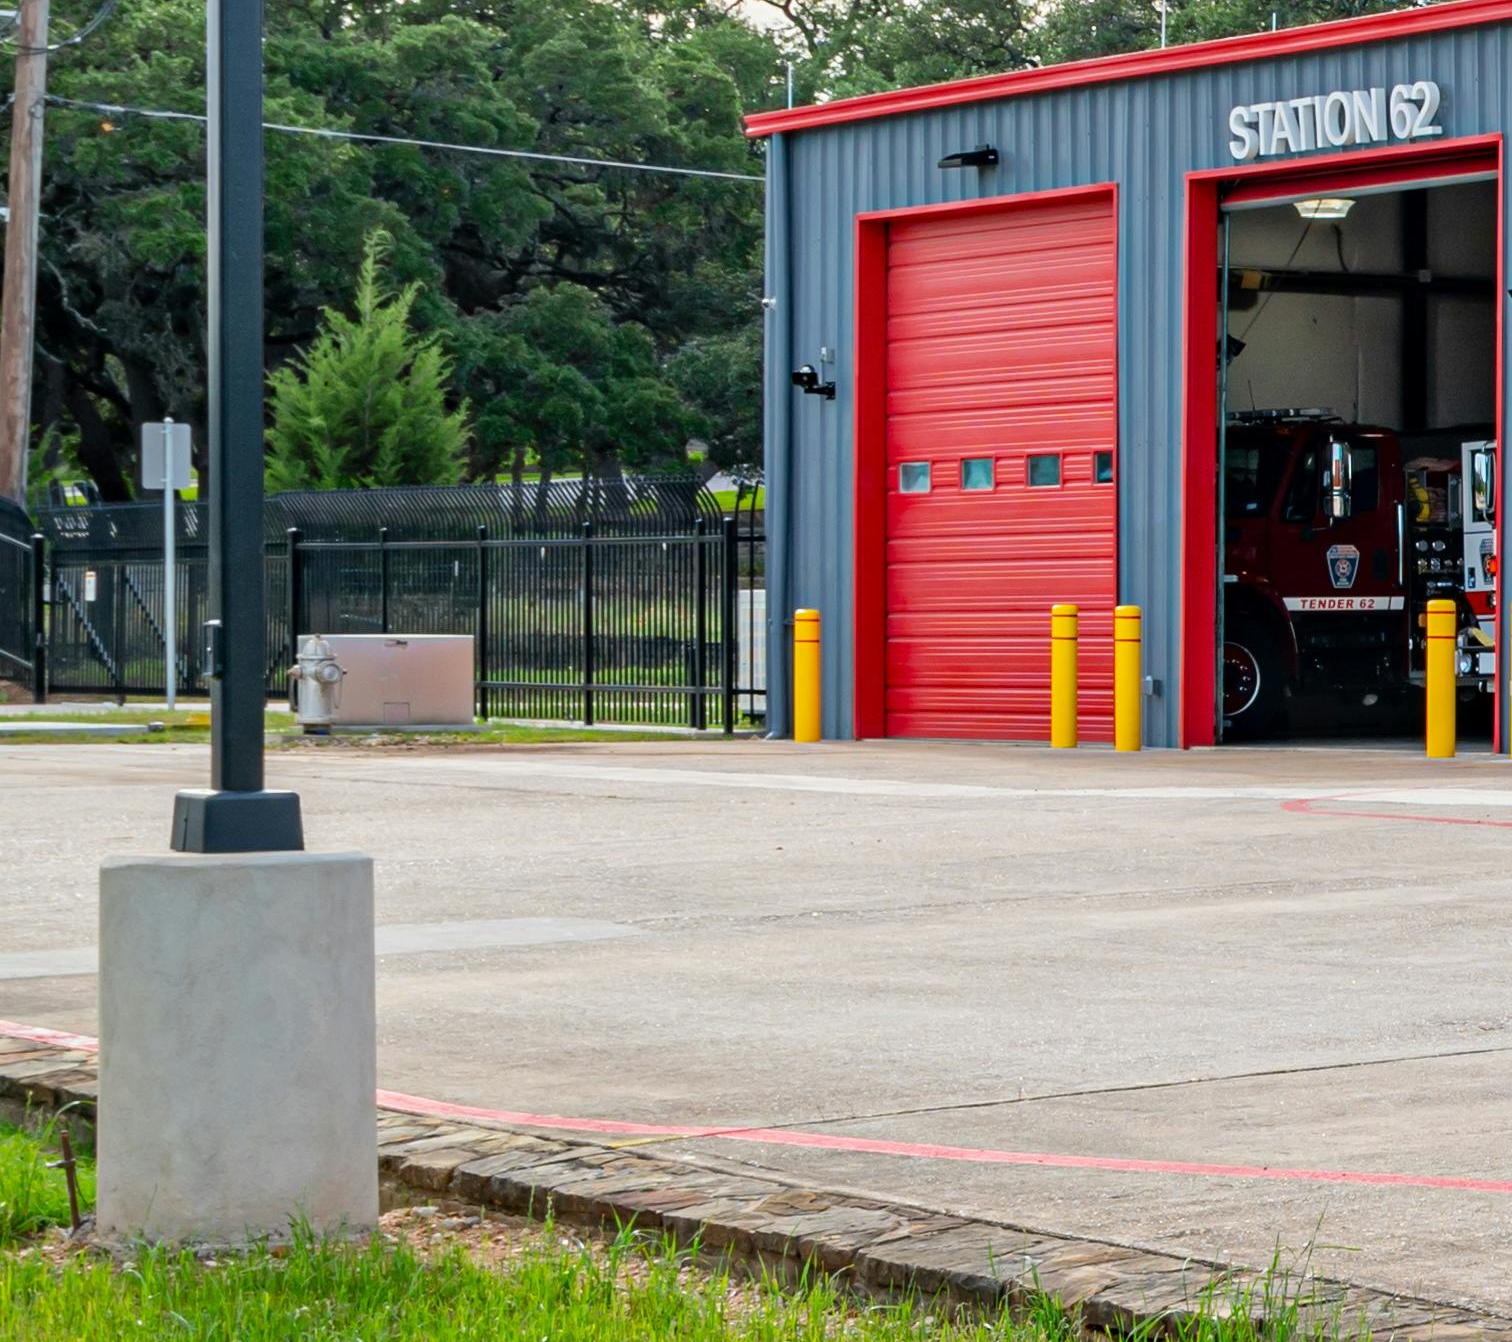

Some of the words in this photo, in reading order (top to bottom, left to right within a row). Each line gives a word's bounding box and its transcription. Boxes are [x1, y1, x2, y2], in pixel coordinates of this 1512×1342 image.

[1229, 88, 1388, 159] STATION
[1390, 81, 1443, 139] 62
[1300, 599, 1354, 609] TENDER
[1359, 599, 1375, 609] 62
